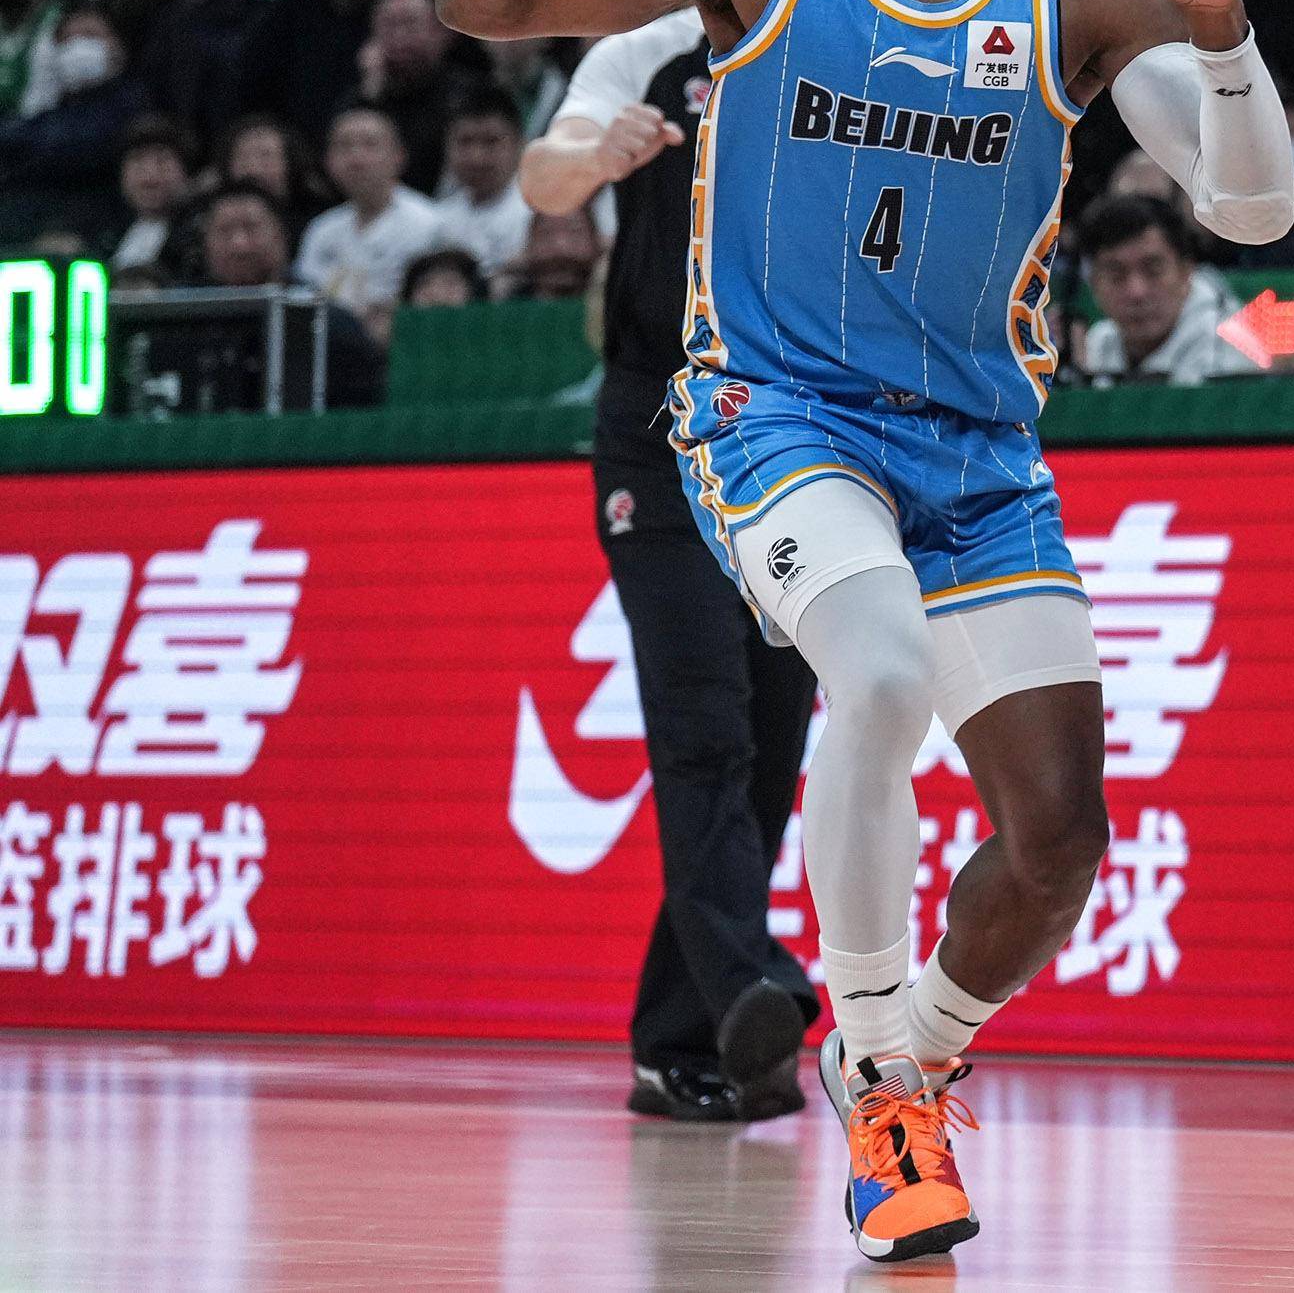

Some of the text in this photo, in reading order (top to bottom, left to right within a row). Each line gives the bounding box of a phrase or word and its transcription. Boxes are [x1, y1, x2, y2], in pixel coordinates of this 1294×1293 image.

[974, 62, 1020, 74] 广发银行
[982, 75, 1010, 87] CGB
[789, 76, 1013, 166] BEIJING
[859, 186, 905, 274] 4
